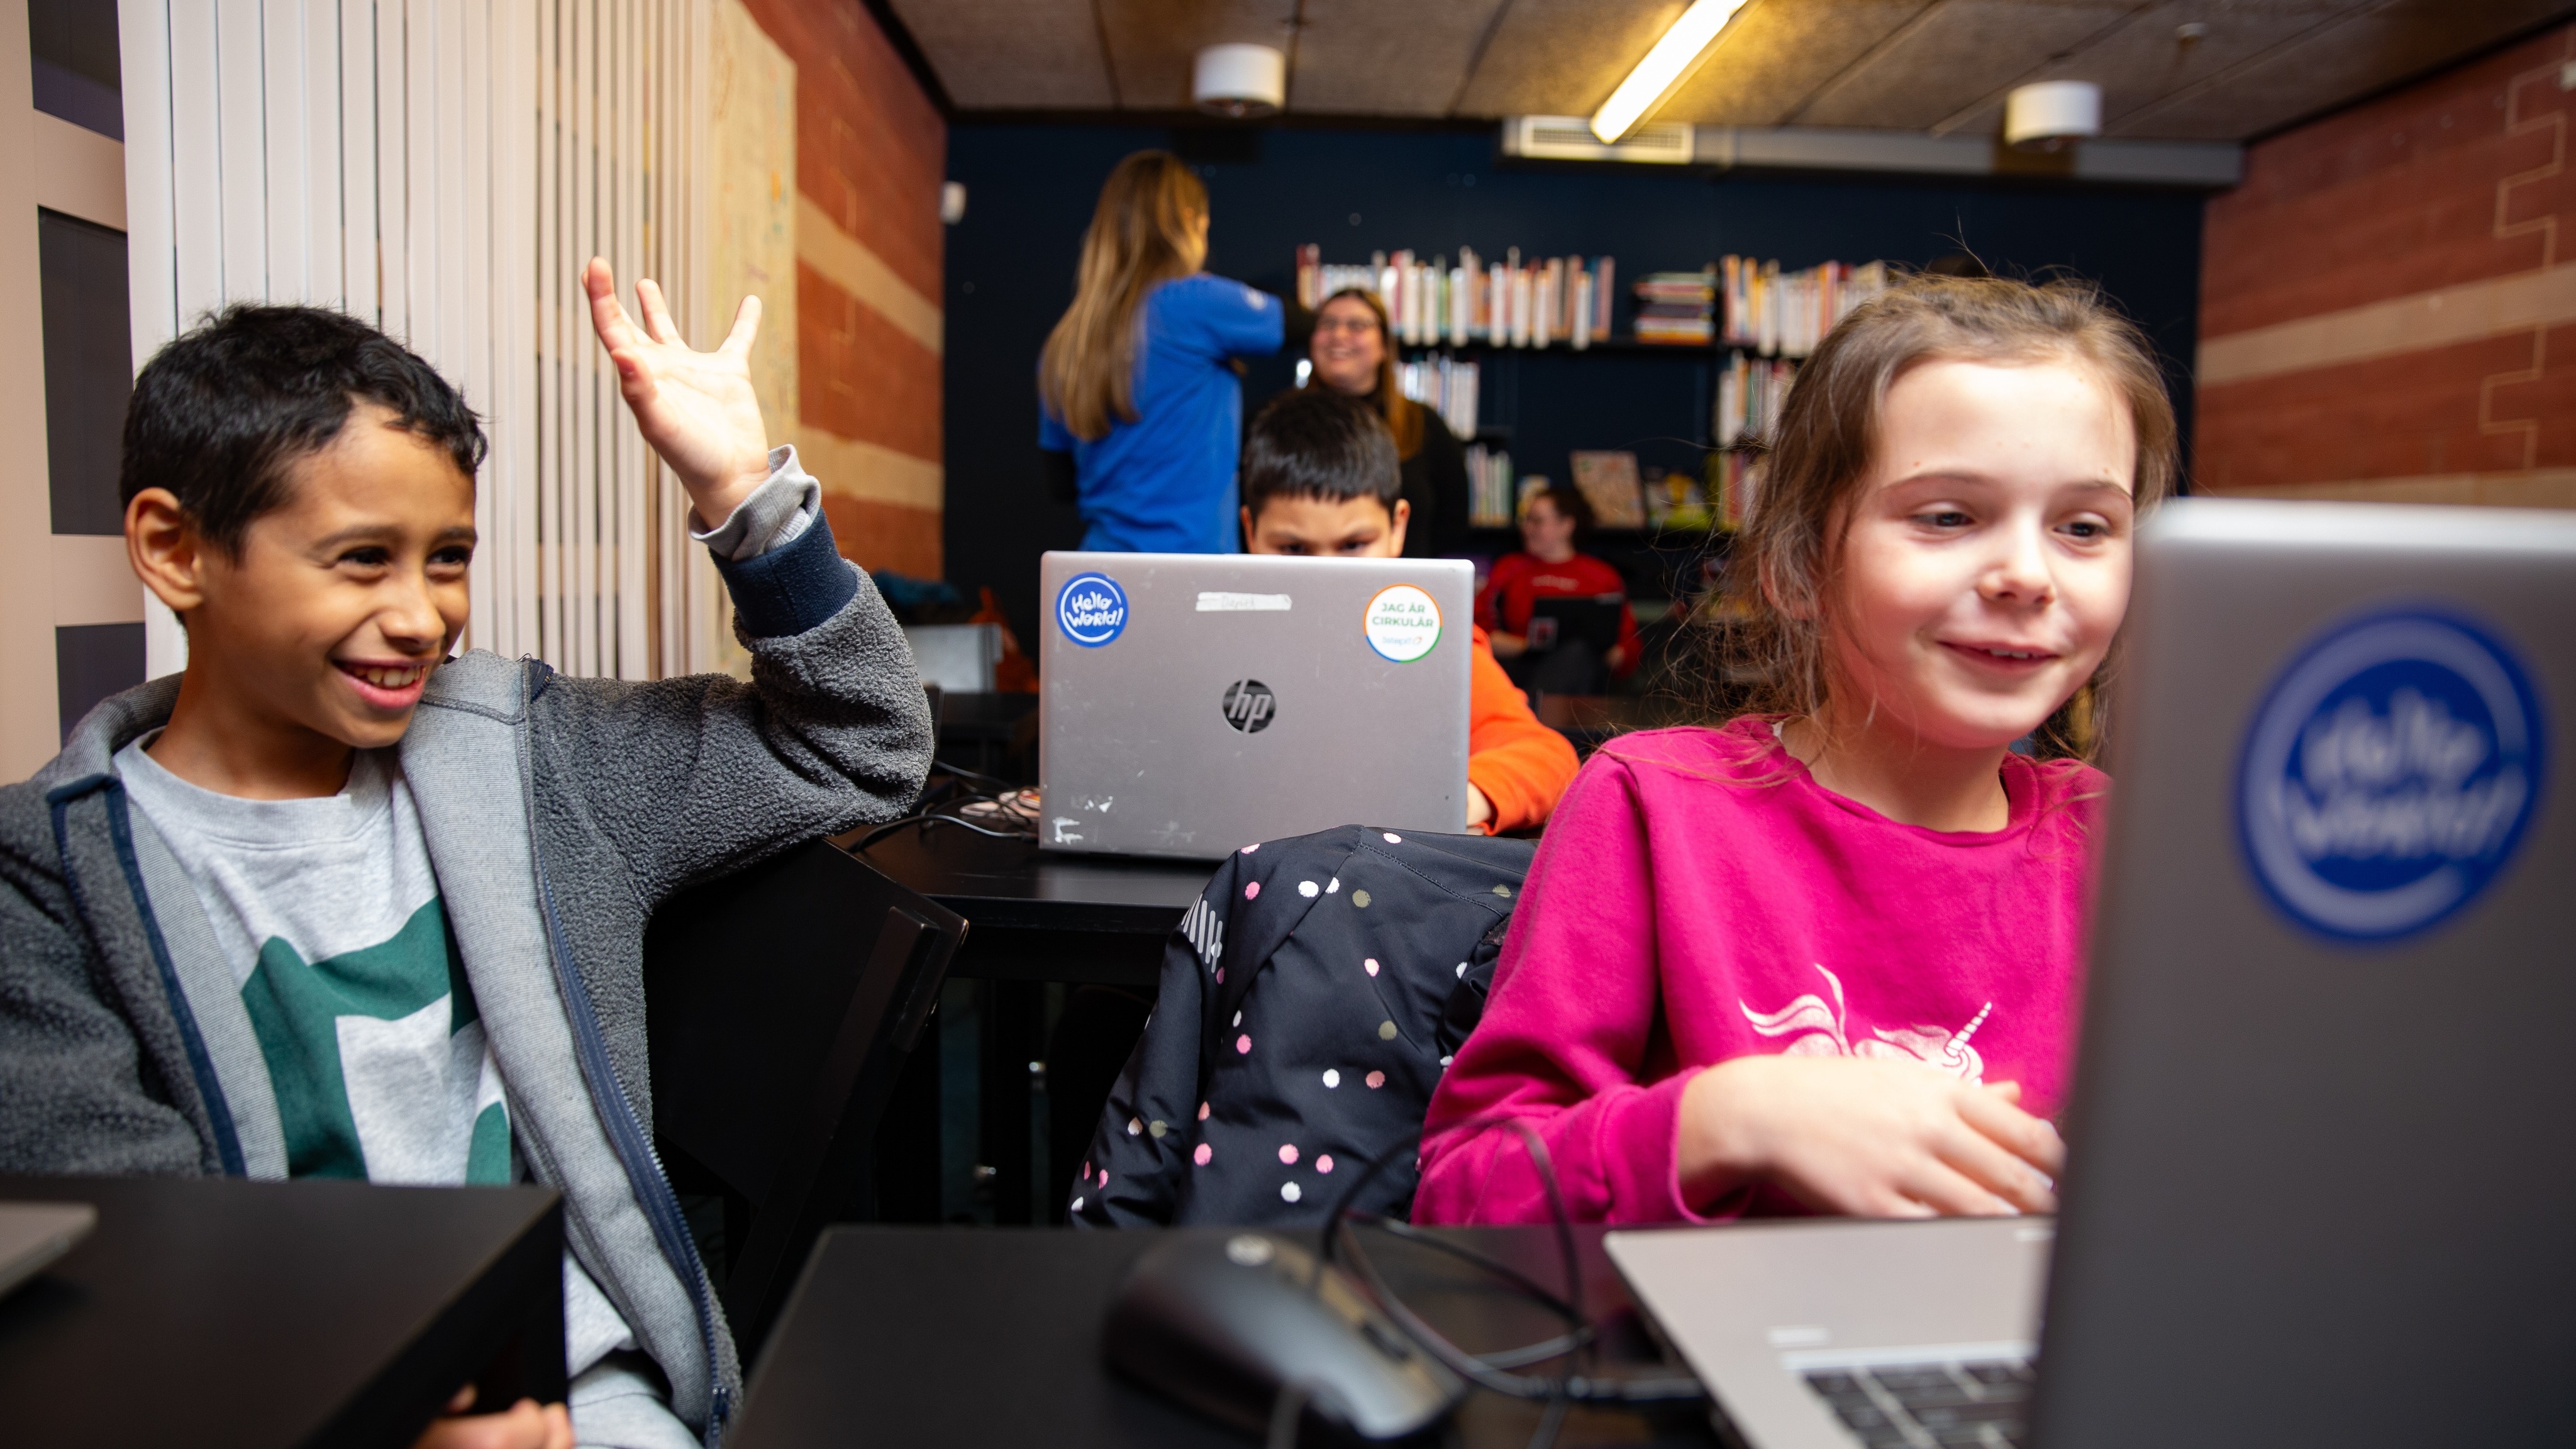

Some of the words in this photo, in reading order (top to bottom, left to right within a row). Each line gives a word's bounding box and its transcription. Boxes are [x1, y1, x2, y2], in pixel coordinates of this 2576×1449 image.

[1072, 591, 1113, 614] Hello
[1382, 603, 1404, 613] JAG
[1227, 679, 1272, 733] hp
